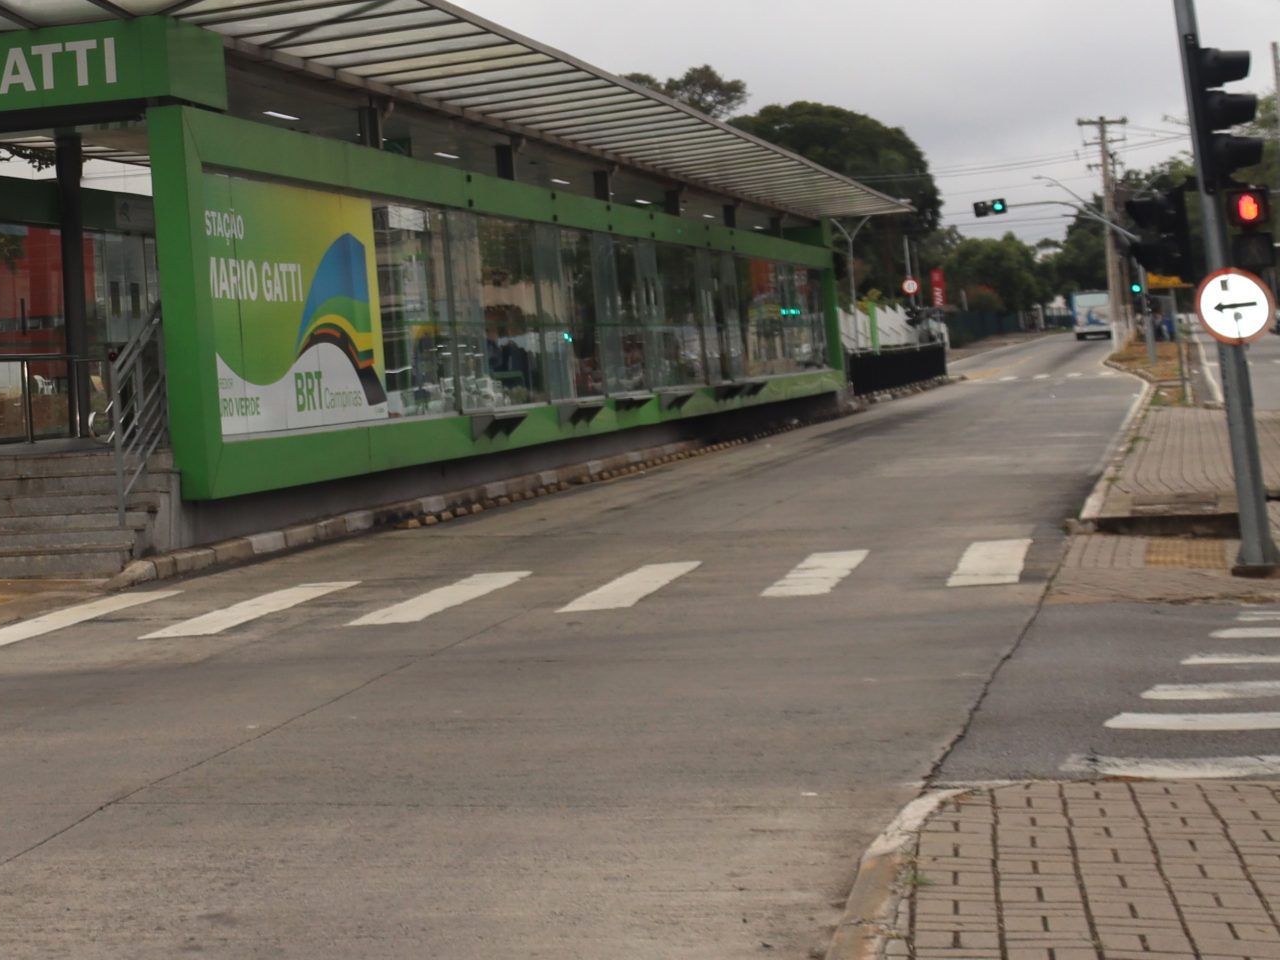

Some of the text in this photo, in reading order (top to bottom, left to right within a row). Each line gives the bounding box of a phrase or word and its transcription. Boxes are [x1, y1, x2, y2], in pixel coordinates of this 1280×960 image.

[205, 208, 244, 246] STAÇÃO
[261, 261, 304, 302] GATTI
[234, 396, 261, 417] VERDE
[294, 370, 363, 413] BRT Campinas
